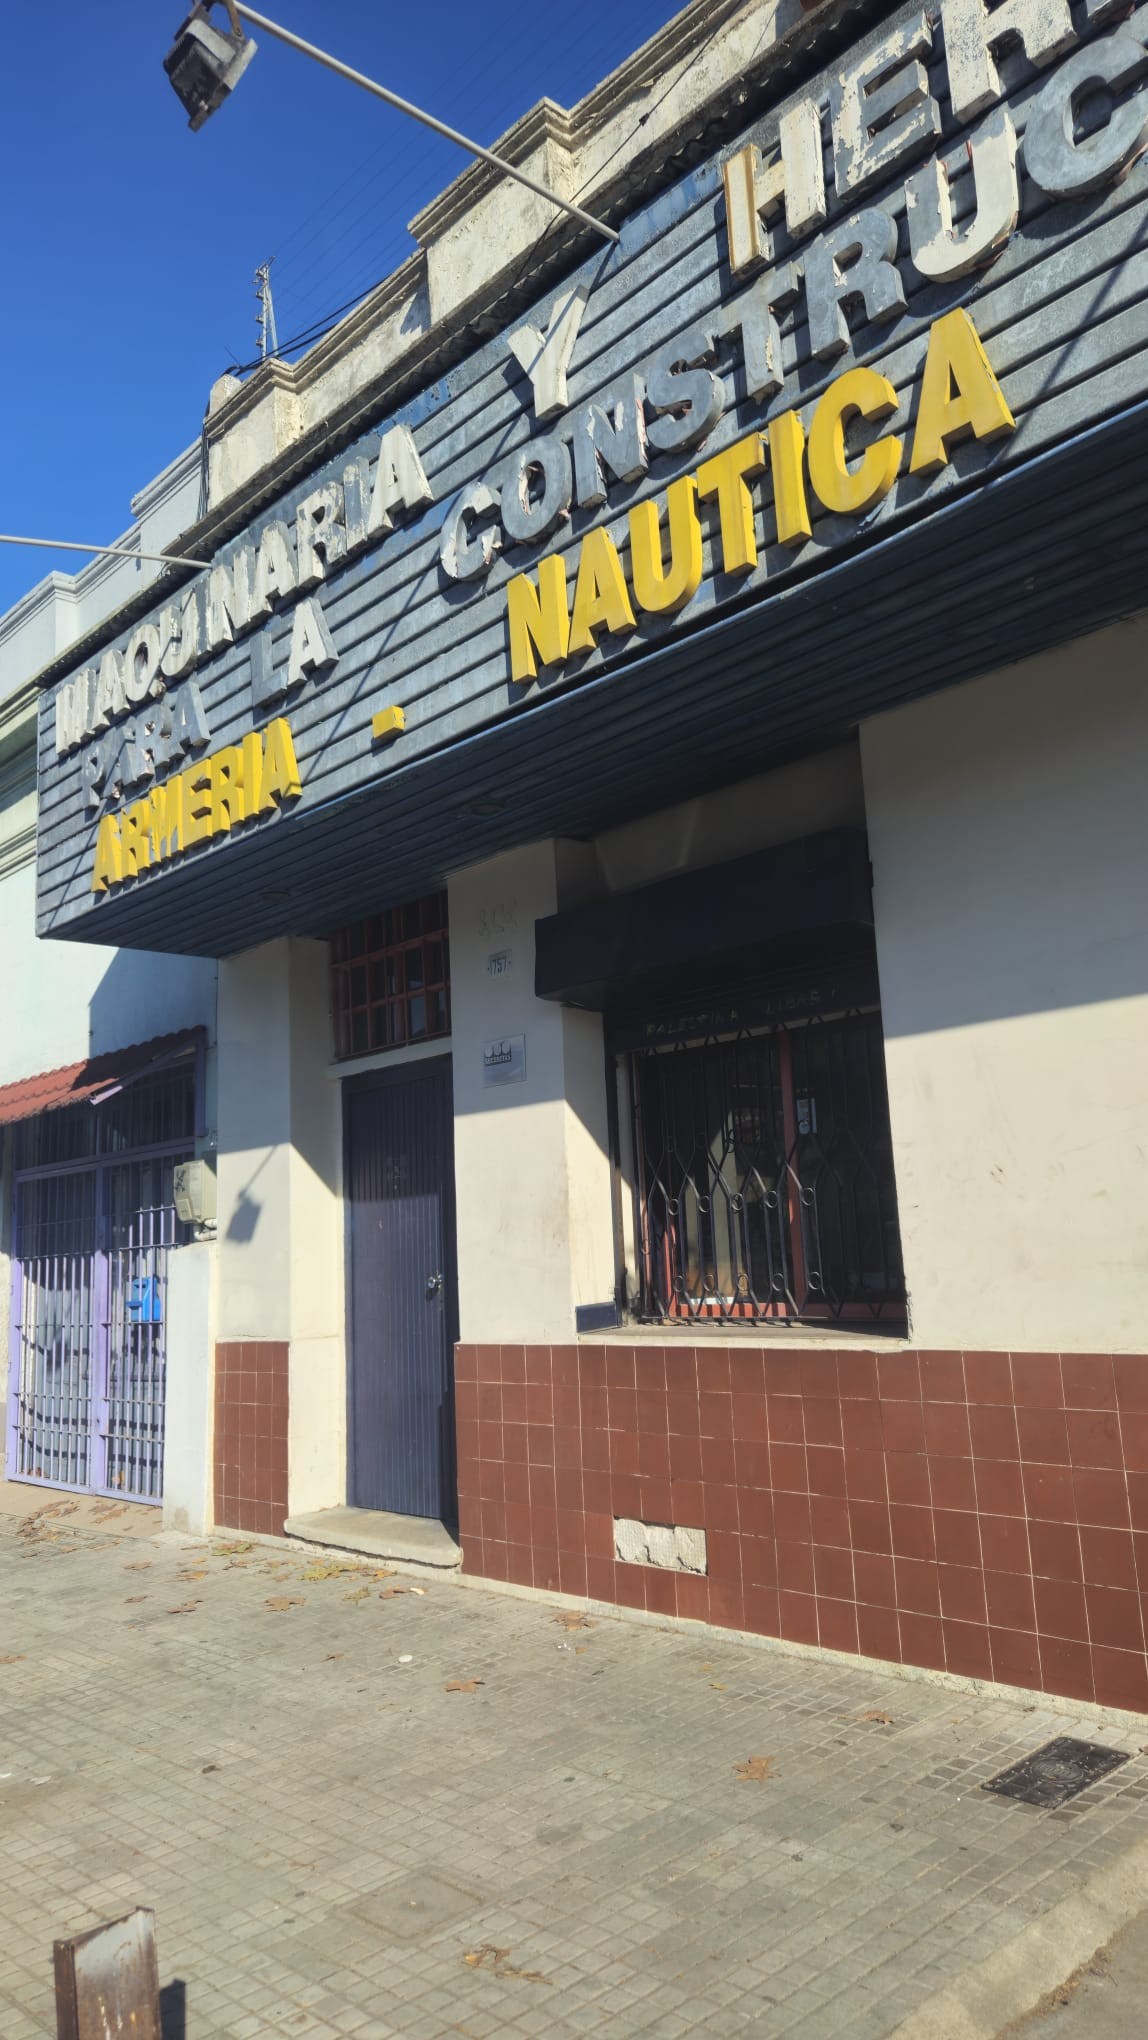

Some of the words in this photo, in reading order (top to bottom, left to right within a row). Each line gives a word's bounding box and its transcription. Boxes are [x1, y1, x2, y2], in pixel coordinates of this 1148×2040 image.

[55, 424, 433, 755] MAQUINARIA
[507, 286, 590, 419] Y
[723, 0, 1135, 277] HER
[81, 680, 211, 807] PARA
[251, 597, 339, 704] LA
[440, 35, 1148, 582] CONSTRUC
[91, 717, 302, 892] ARMERIA
[507, 307, 1016, 683] NAUTICA
